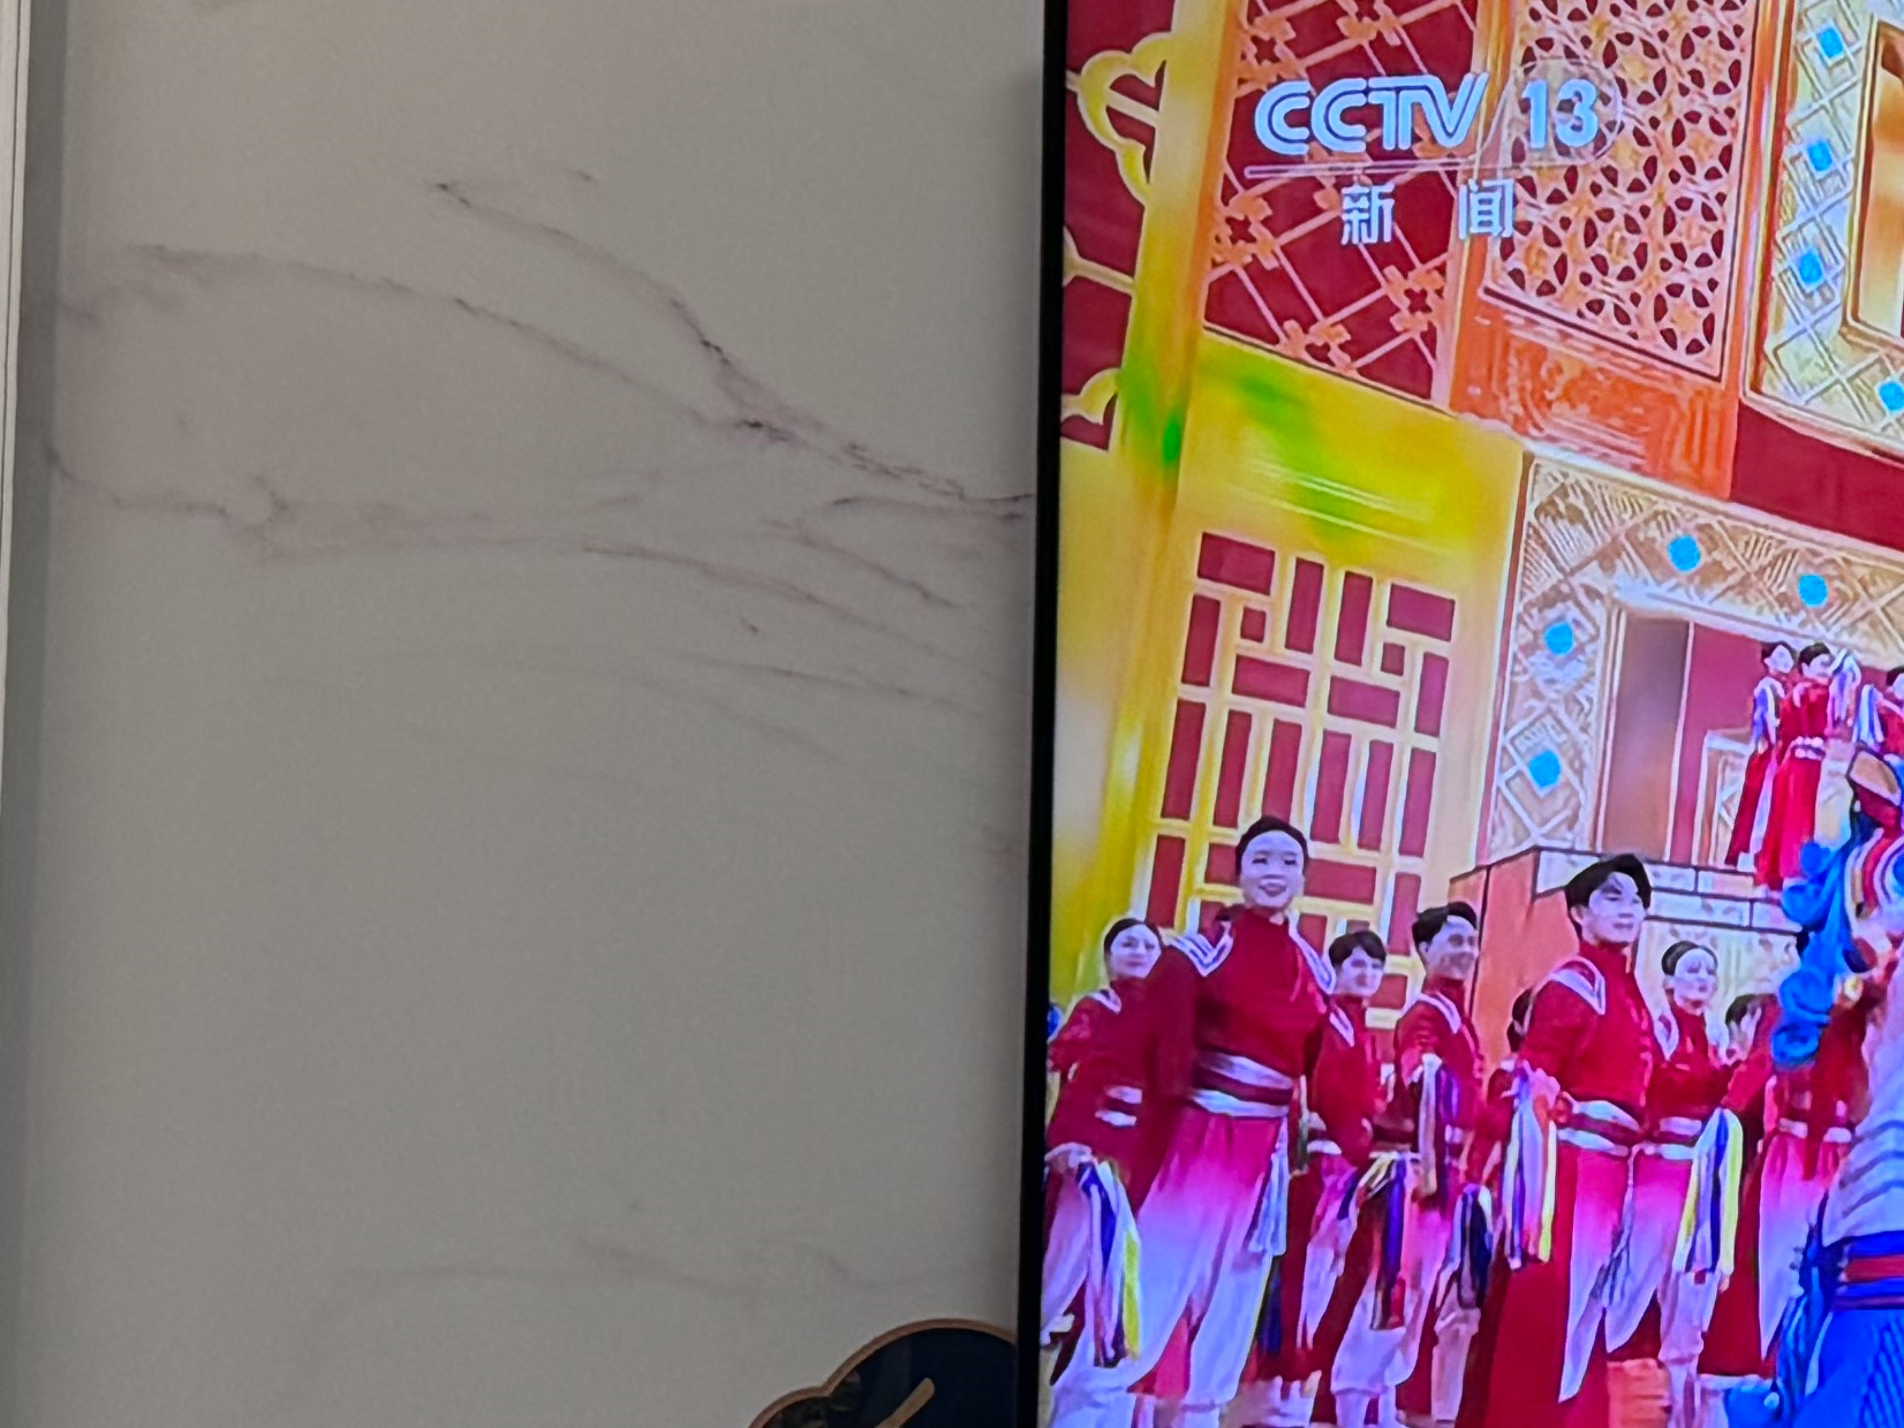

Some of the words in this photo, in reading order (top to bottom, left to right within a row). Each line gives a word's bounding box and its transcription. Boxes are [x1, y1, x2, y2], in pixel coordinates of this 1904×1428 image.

[1254, 72, 1489, 156] CCTV
[1522, 78, 1598, 149] 13
[1340, 179, 1515, 246] 新闻
